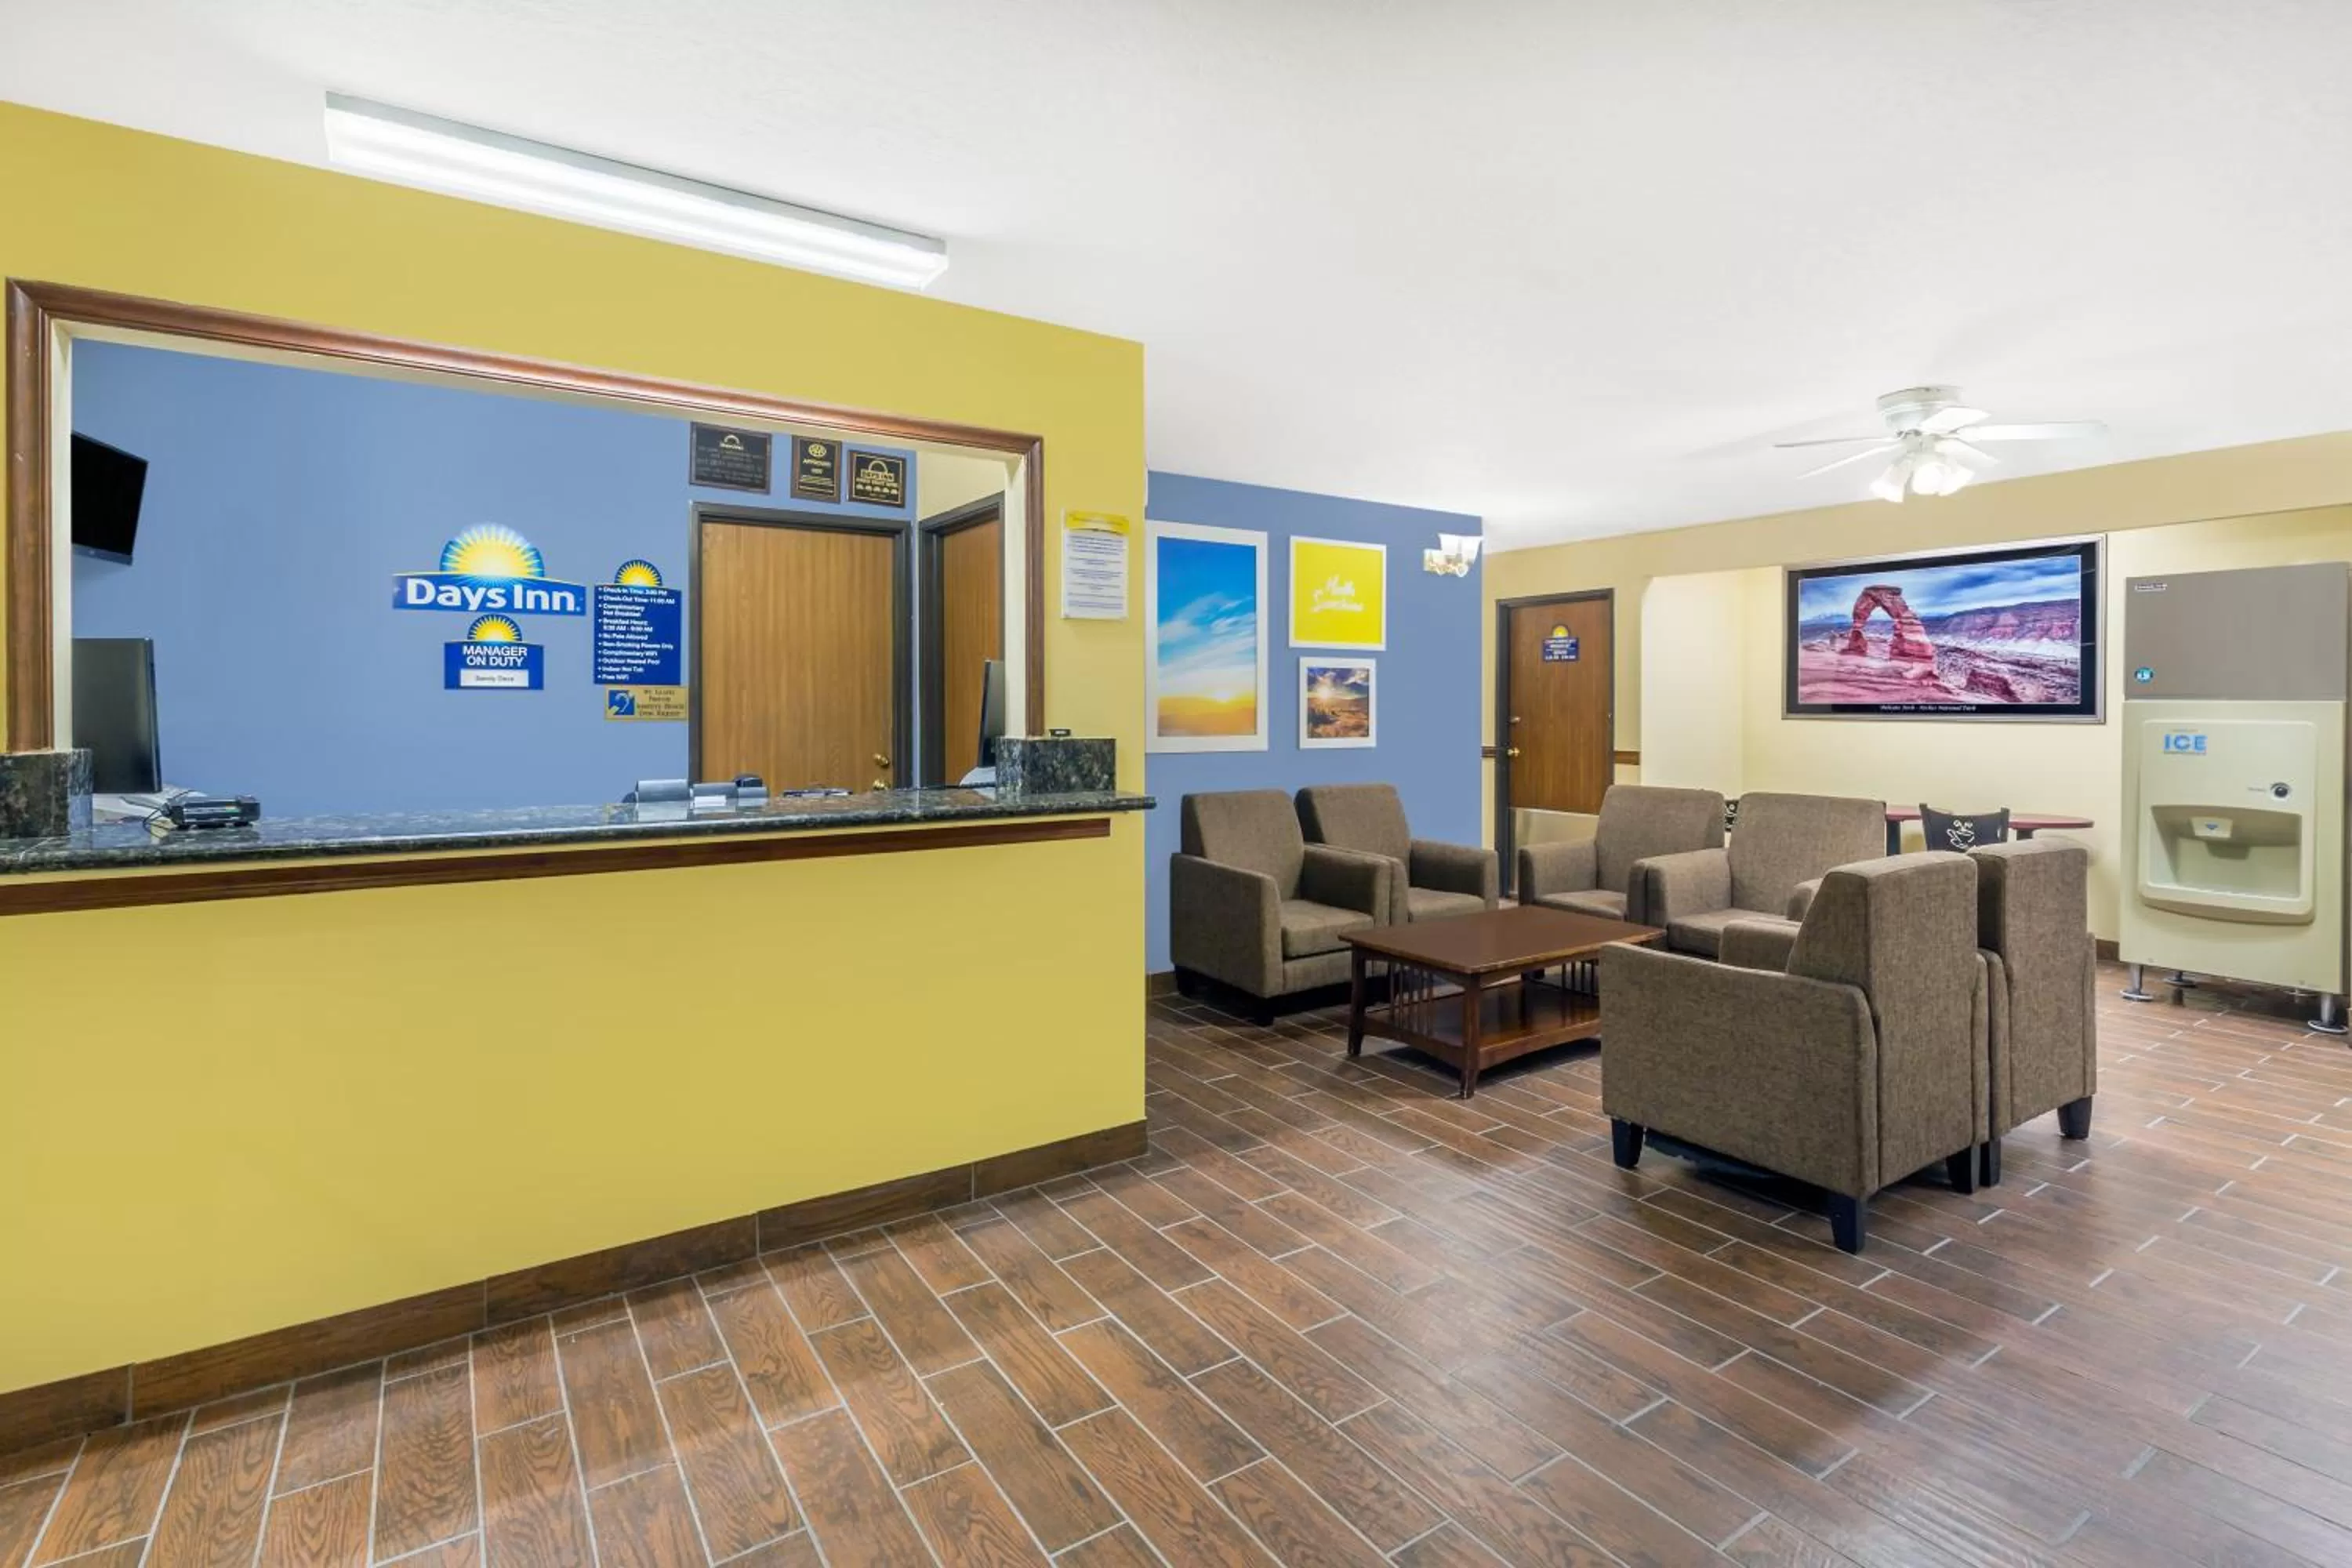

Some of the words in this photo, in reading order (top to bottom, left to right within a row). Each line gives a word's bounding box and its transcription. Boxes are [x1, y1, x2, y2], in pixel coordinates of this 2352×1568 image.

[406, 578, 507, 612] Days
[514, 584, 575, 612] Inn
[463, 645, 528, 656] MANAGER
[466, 656, 486, 666] ON
[489, 656, 524, 667] DUTY
[2164, 734, 2208, 751] ICE
